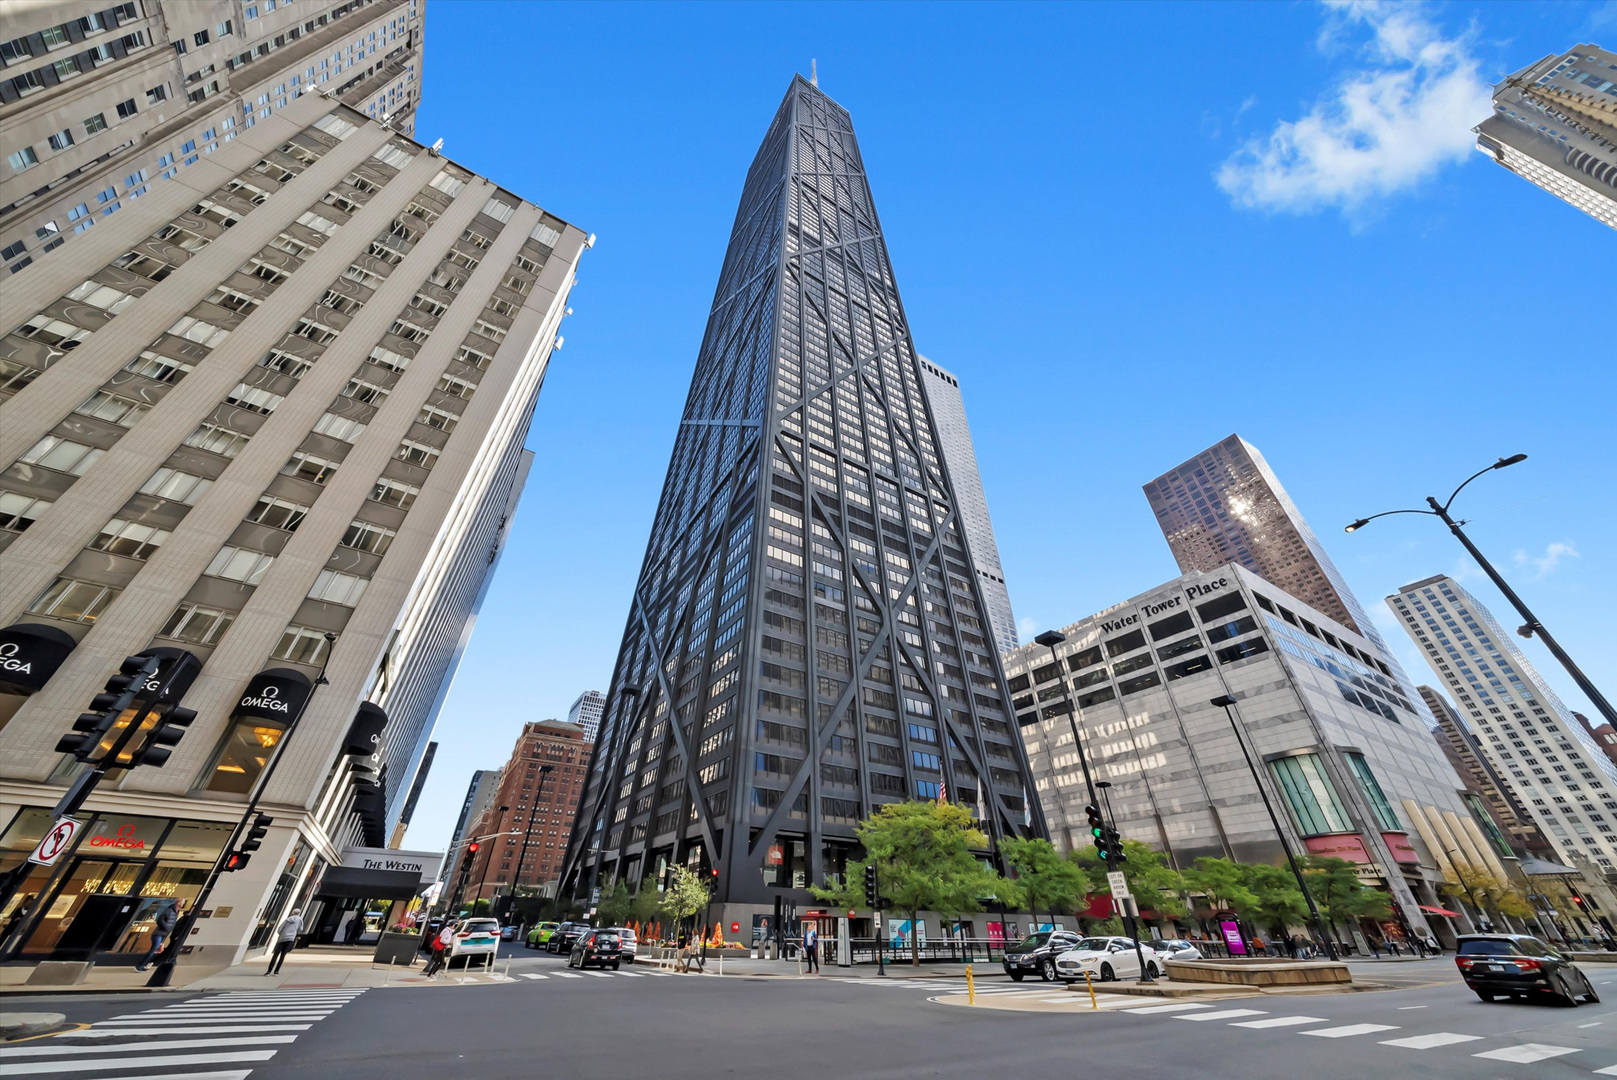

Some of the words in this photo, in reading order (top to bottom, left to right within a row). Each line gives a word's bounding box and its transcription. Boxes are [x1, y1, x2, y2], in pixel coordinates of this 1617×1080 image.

[1101, 613, 1138, 634] Water
[1141, 596, 1181, 617] Tower
[1185, 577, 1227, 600] Place
[241, 697, 288, 713] OMEGA
[90, 836, 144, 849] OMEGA
[364, 859, 382, 869] THE
[386, 861, 422, 871] WESTIN
